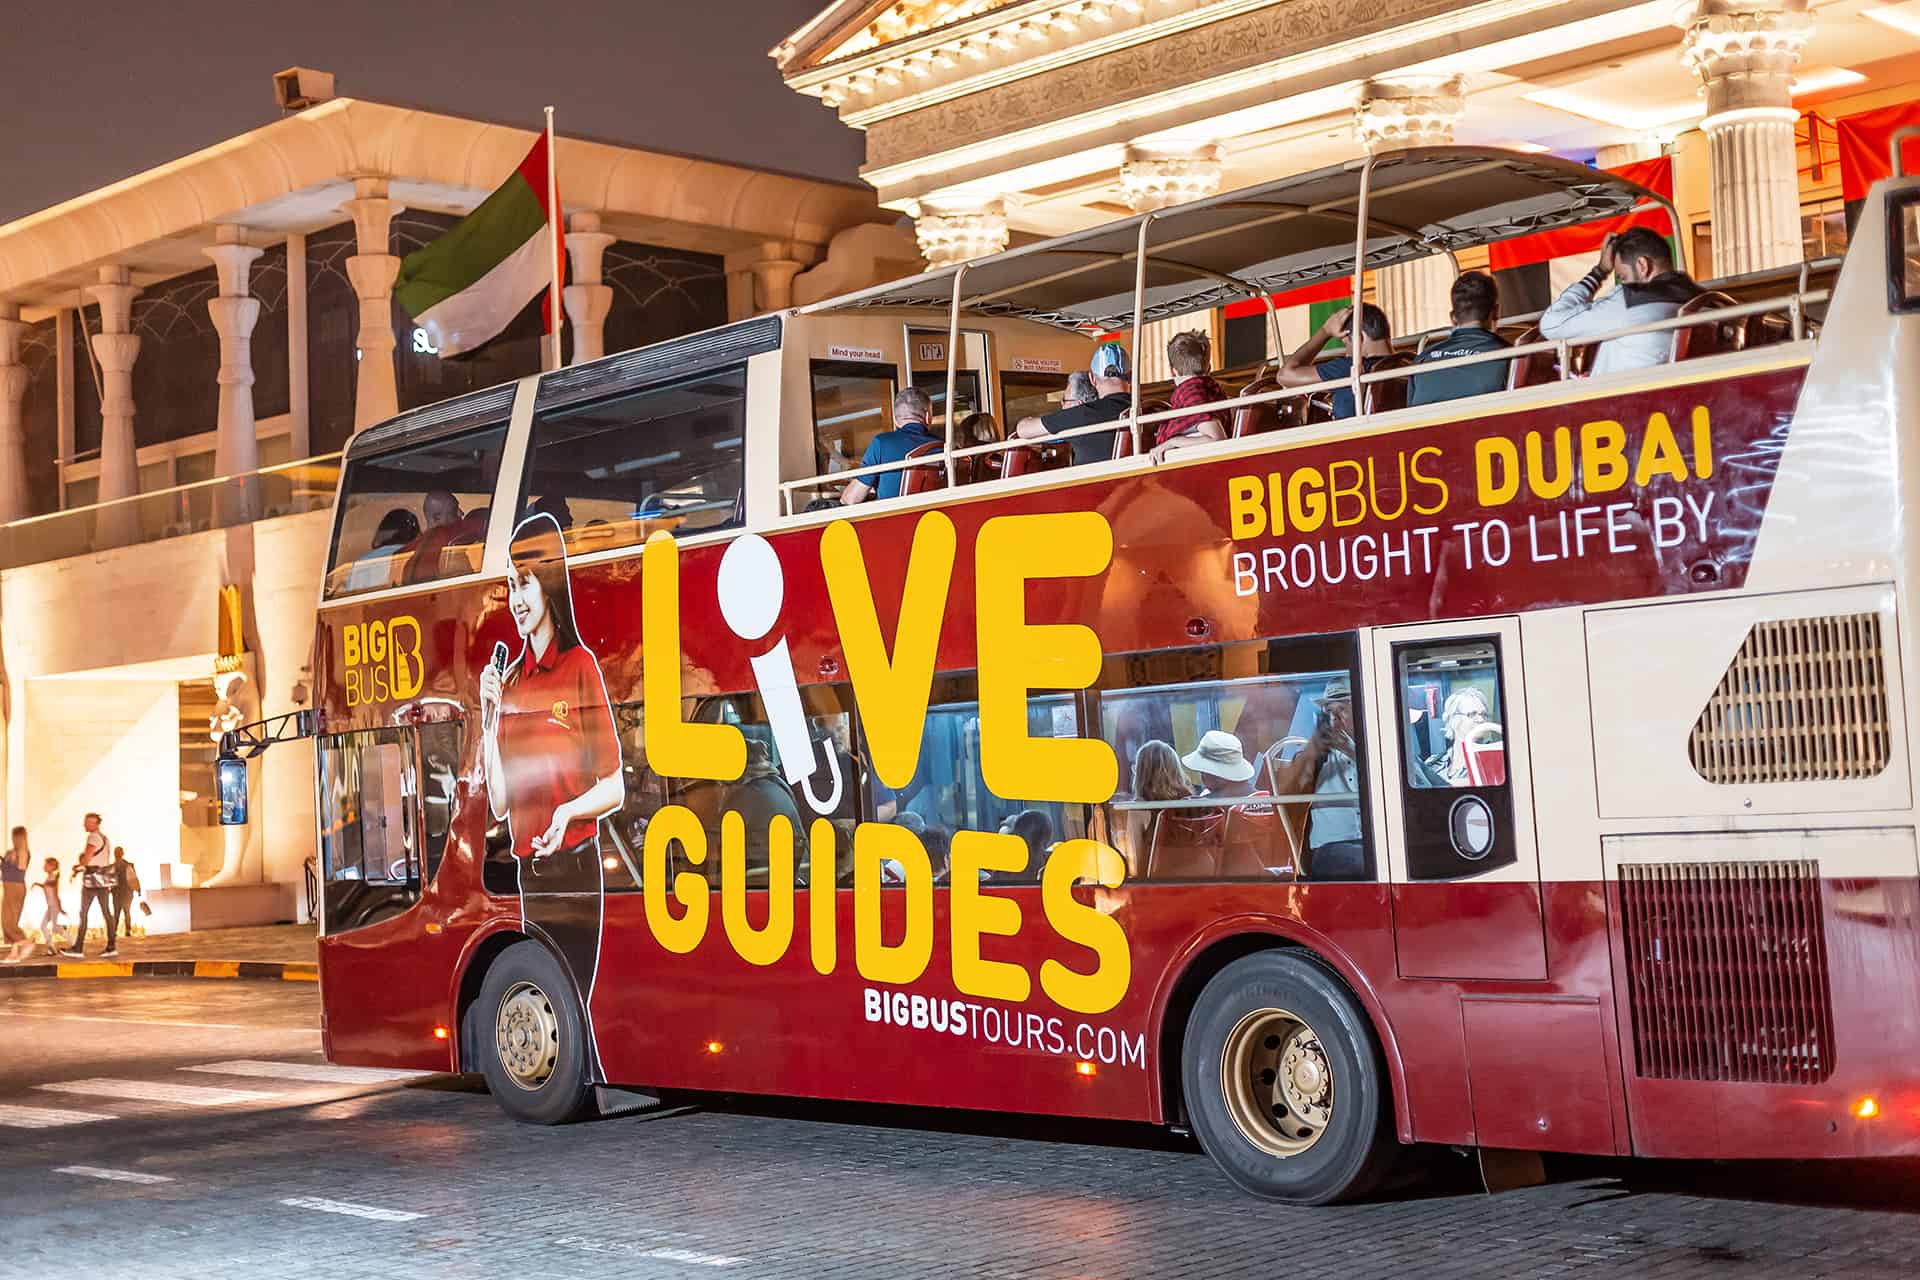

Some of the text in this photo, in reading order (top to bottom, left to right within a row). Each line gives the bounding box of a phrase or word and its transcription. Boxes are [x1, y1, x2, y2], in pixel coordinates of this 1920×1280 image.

[832, 347, 880, 359] Mind your head
[1228, 405, 1714, 541] BIGBUS DUBAI
[1232, 490, 1715, 597] BROUGHT TO LIFE BY
[343, 620, 387, 666] BIG
[345, 665, 389, 707] BUS
[643, 804, 1132, 1014] GUIDES
[863, 988, 1146, 1070] BIGBUSTOURS.COM
